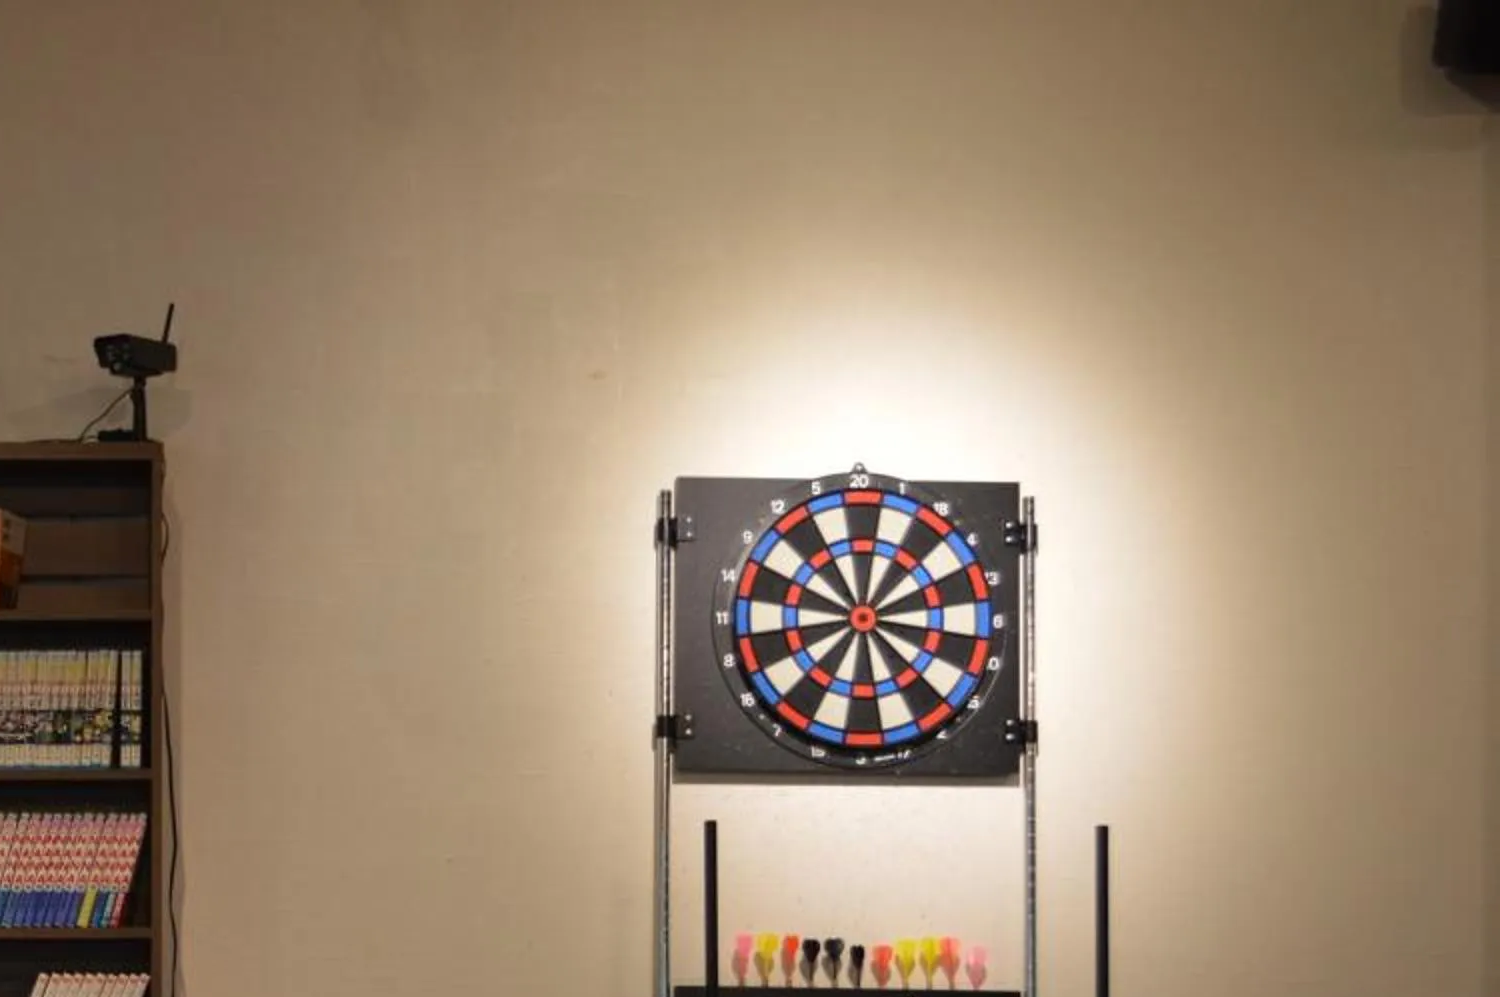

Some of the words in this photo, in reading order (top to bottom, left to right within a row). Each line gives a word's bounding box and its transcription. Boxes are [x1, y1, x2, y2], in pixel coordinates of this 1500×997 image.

[811, 481, 821, 495] 5
[849, 475, 869, 488] 20
[900, 482, 907, 495] 1
[770, 499, 785, 515] 12
[933, 501, 949, 516] 18
[743, 530, 753, 544] 9
[967, 532, 979, 546] 4
[721, 568, 736, 583] 14
[716, 611, 729, 625] 11
[993, 614, 1003, 629] 6
[724, 653, 735, 667] 8
